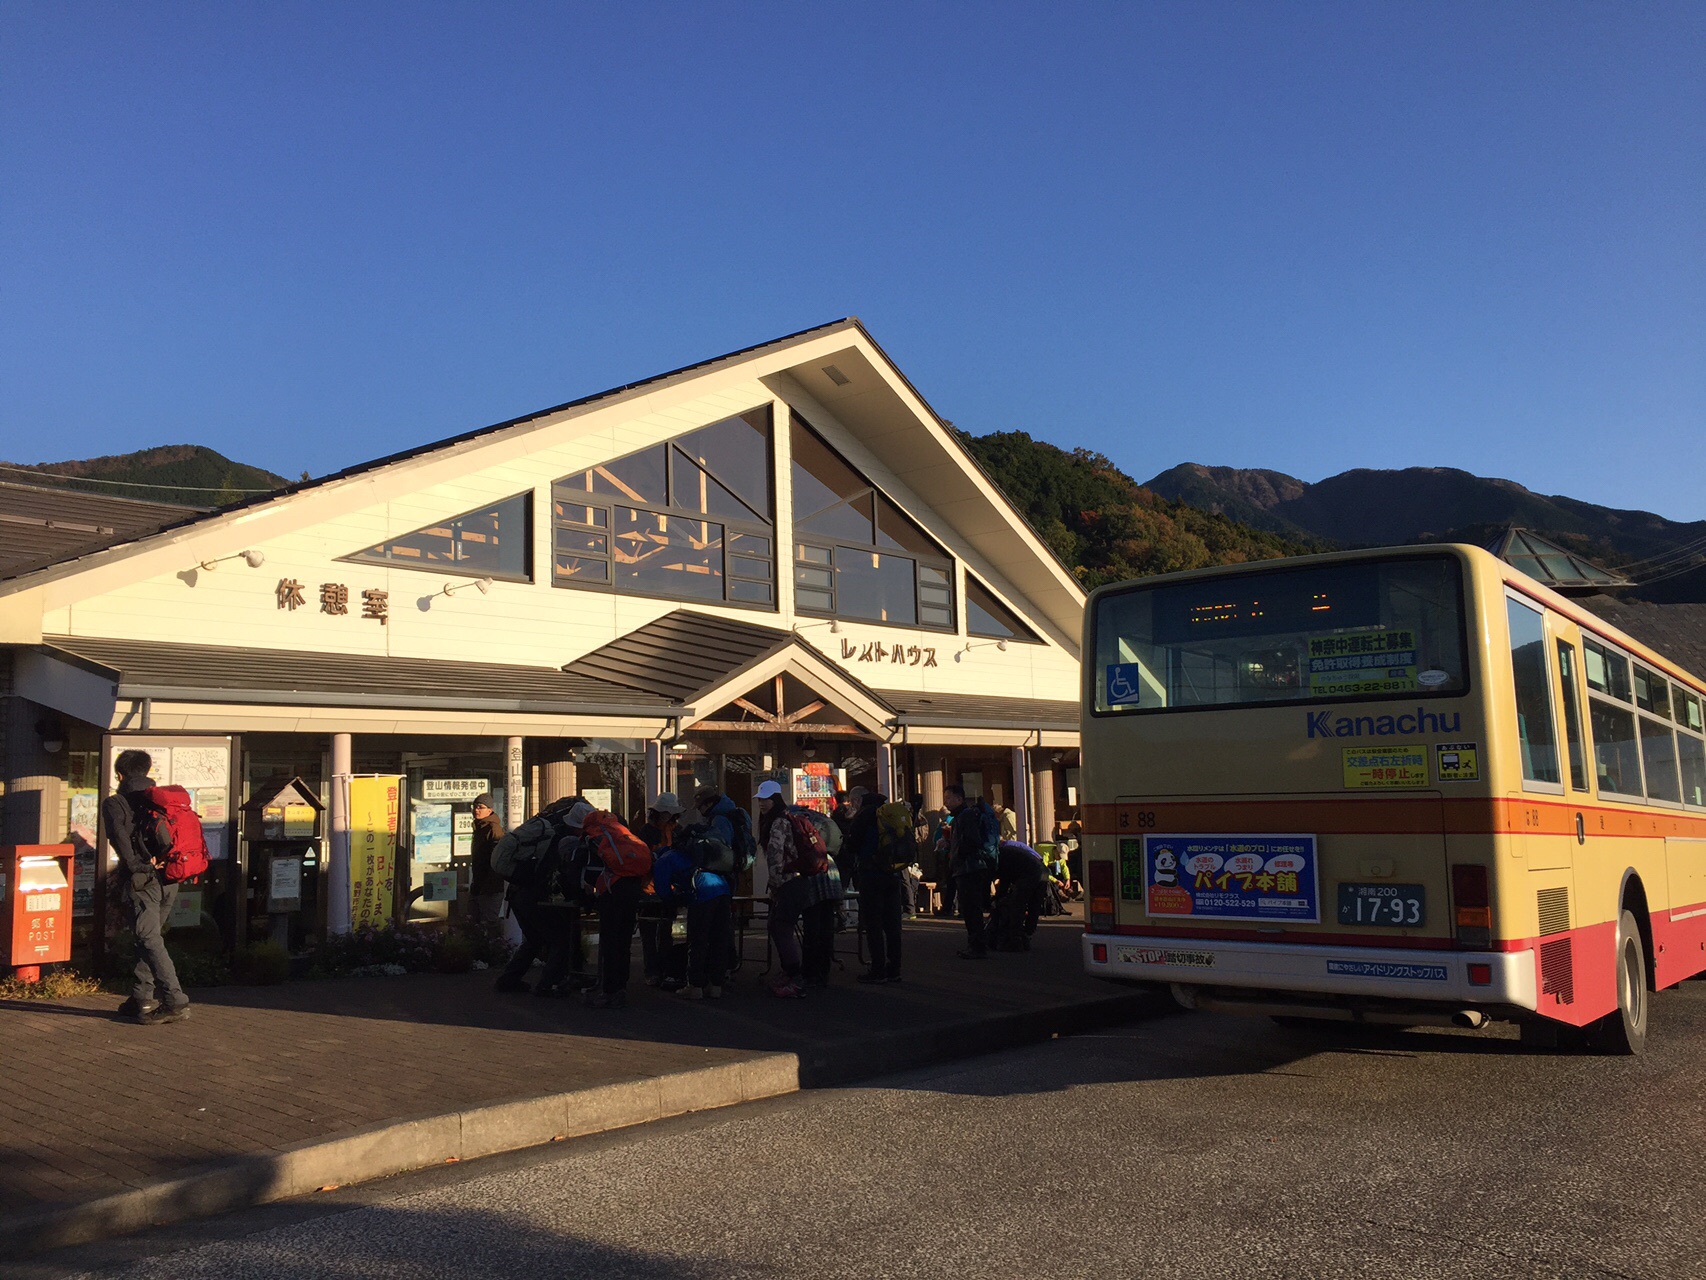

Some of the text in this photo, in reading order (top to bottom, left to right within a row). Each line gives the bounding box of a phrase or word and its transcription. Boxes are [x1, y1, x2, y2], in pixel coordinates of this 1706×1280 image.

[275, 578, 388, 625] 休憩室
[1311, 632, 1412, 656] 神奈中運転士募集
[1313, 680, 1414, 694] TEL 0463-22-8811
[1307, 708, 1460, 738] Kanachu
[1347, 755, 1424, 767] 交差点右左折時
[426, 780, 486, 791] 登山情報発信中
[1120, 812, 1156, 828] は 88
[1122, 843, 1141, 899] 乗降中
[1194, 870, 1298, 893] パイプ本舗
[1204, 898, 1256, 907] 0120-522-529
[1356, 898, 1420, 923] 17-93
[32, 917, 55, 929] 郵便
[29, 930, 55, 941] POST
